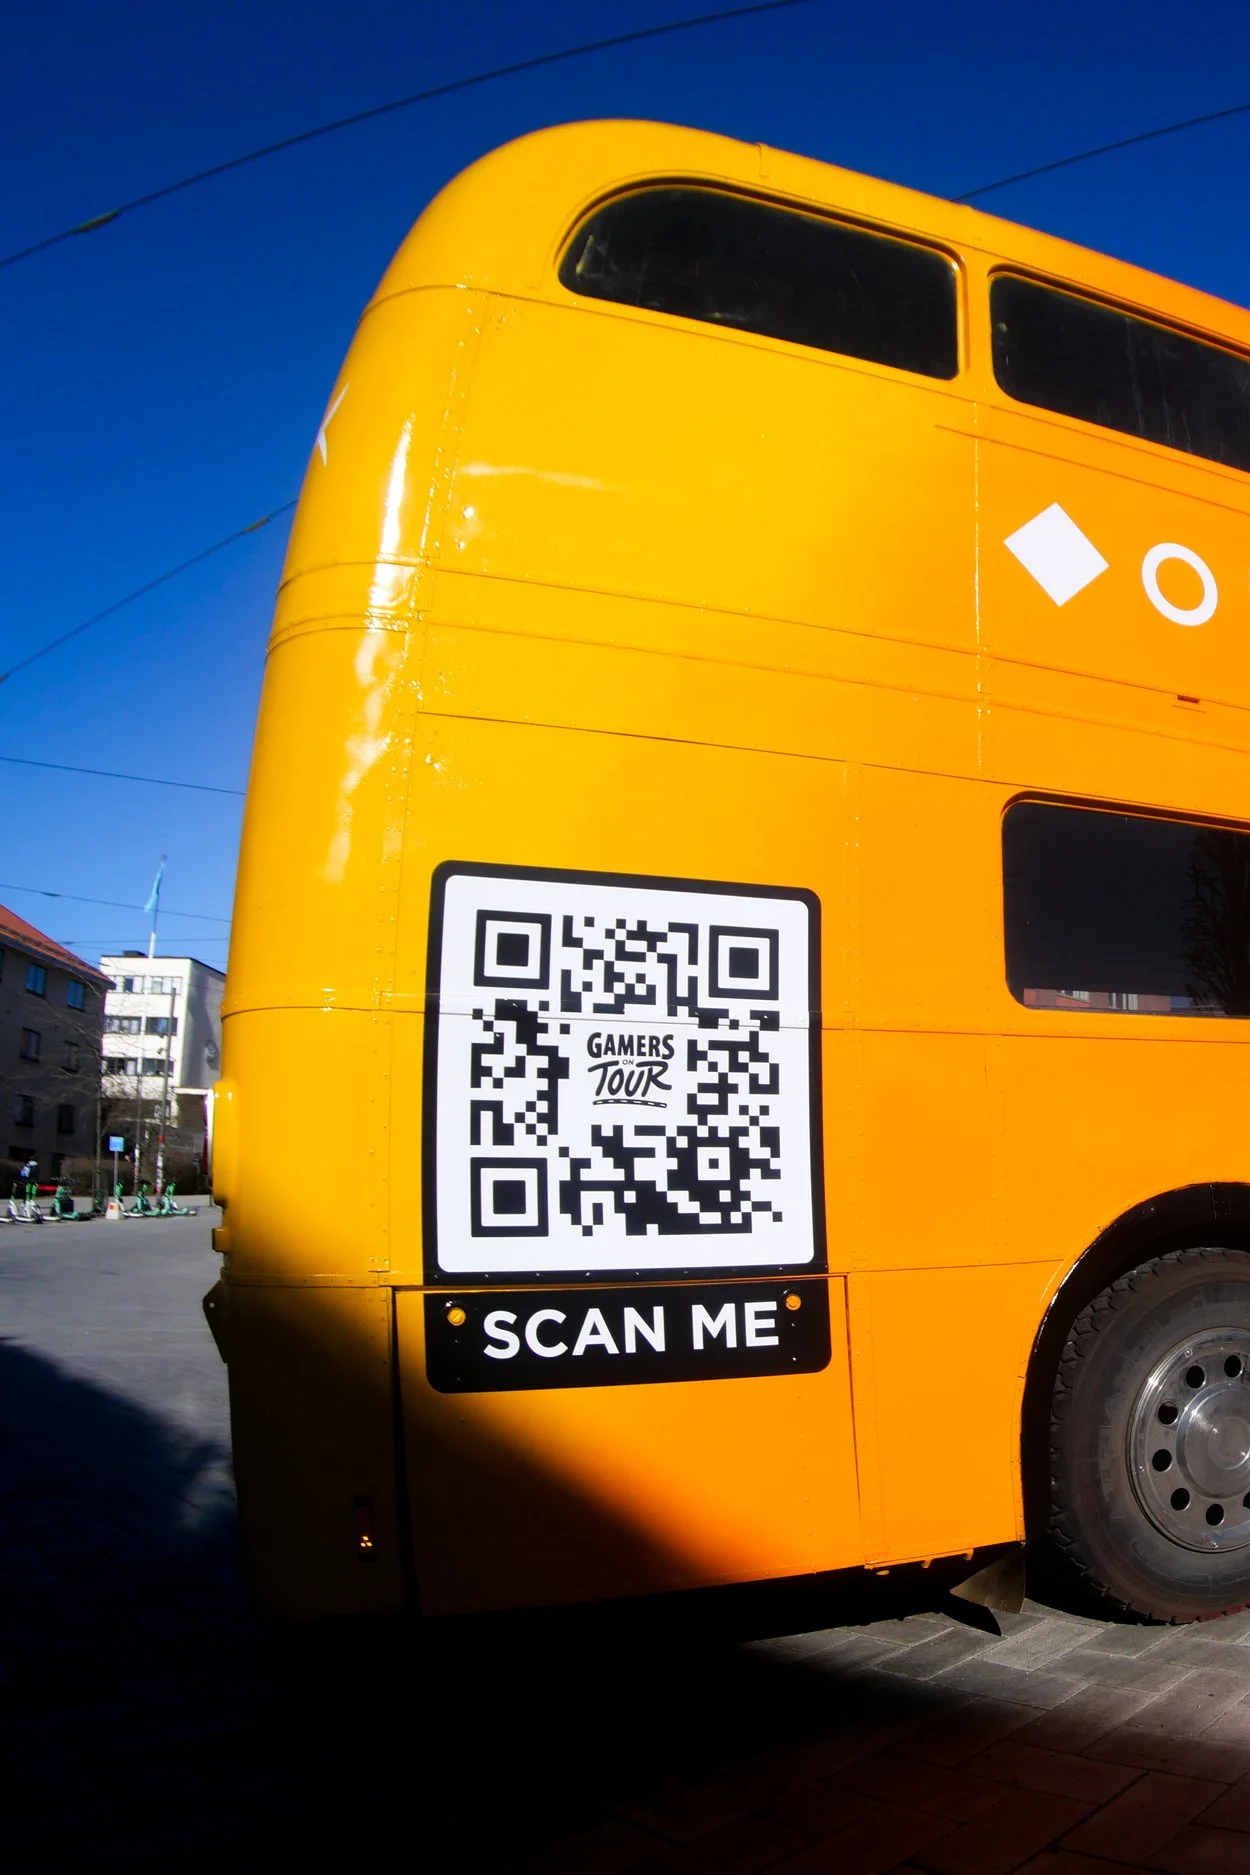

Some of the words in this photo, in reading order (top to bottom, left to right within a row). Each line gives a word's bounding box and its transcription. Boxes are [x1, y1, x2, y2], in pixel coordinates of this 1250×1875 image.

[586, 1032, 675, 1060] GAMERS
[587, 1060, 672, 1097] TOUR
[482, 1305, 667, 1360] SCAN
[690, 1300, 780, 1351] ME
